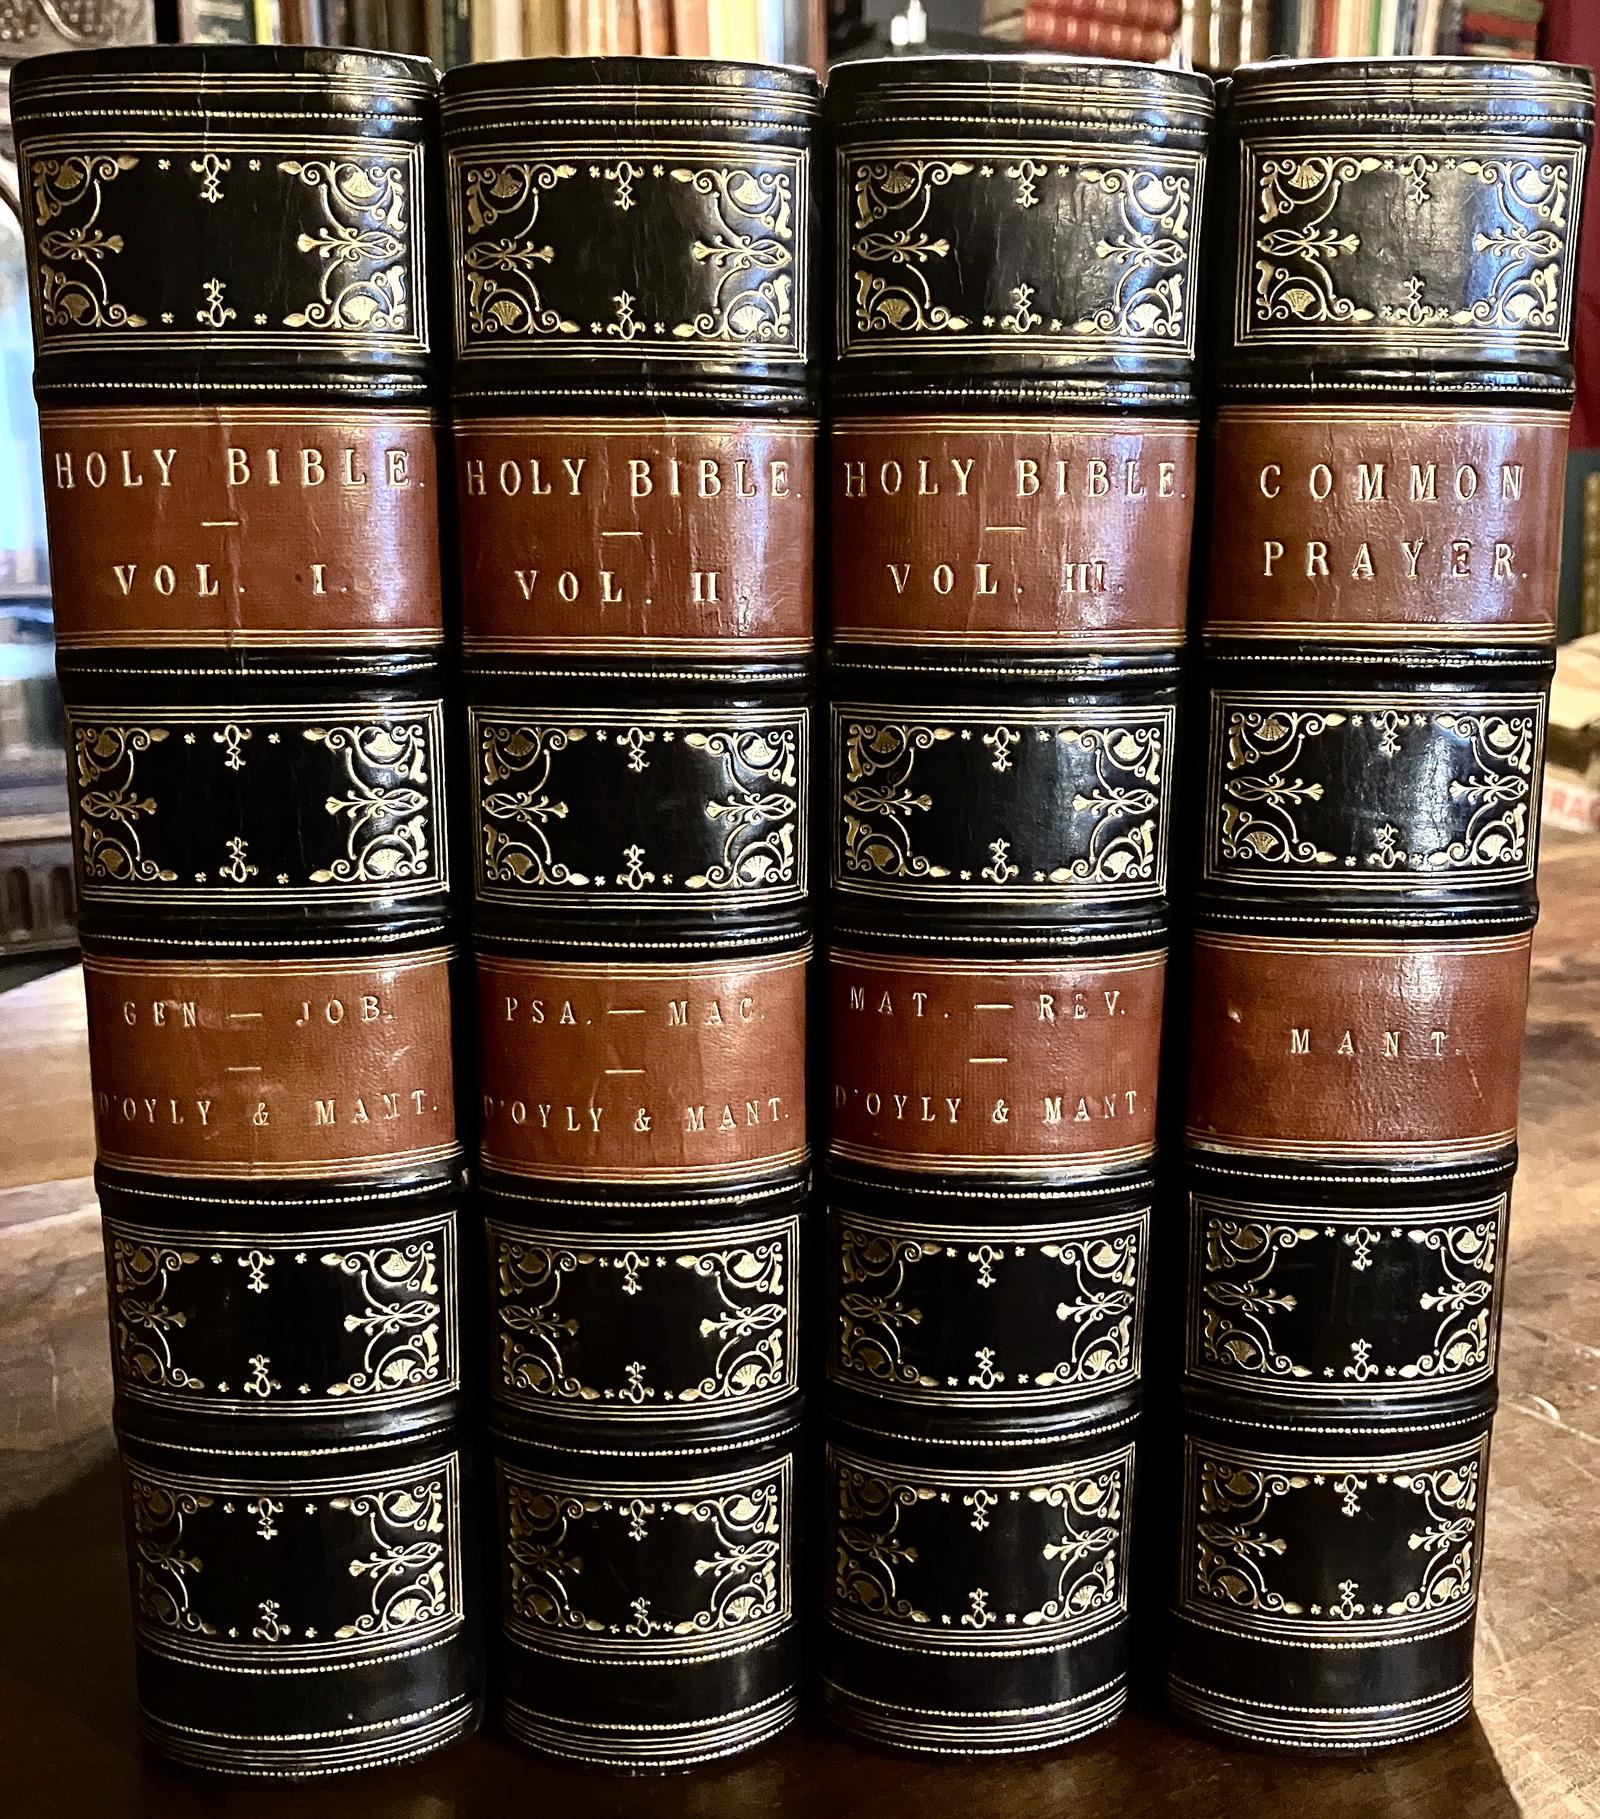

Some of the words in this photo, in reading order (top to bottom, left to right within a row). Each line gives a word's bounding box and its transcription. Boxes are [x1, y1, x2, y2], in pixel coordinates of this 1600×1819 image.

[55, 448, 177, 489] HOLY
[227, 448, 425, 488] BIBLE.
[466, 458, 586, 497] HOLY
[628, 458, 802, 498] BIBLE.
[844, 458, 976, 498] HOLY
[1015, 458, 1187, 499] BIBLE.
[1259, 463, 1524, 502] COMMON
[1263, 540, 1528, 579] PRAYER.
[113, 564, 246, 597] VOL.
[311, 564, 349, 596] I.
[514, 570, 653, 605] VOL.
[886, 563, 1024, 595] VOL.
[505, 997, 592, 1026] PSA.
[668, 997, 765, 1027] MAC.
[850, 985, 950, 1019] MAT.
[1038, 990, 1125, 1021] REV.
[253, 1102, 269, 1127] &
[315, 1089, 438, 1126] MANT.
[633, 1107, 652, 1132] &
[686, 1097, 789, 1132] MANT.
[991, 1099, 1010, 1124] &
